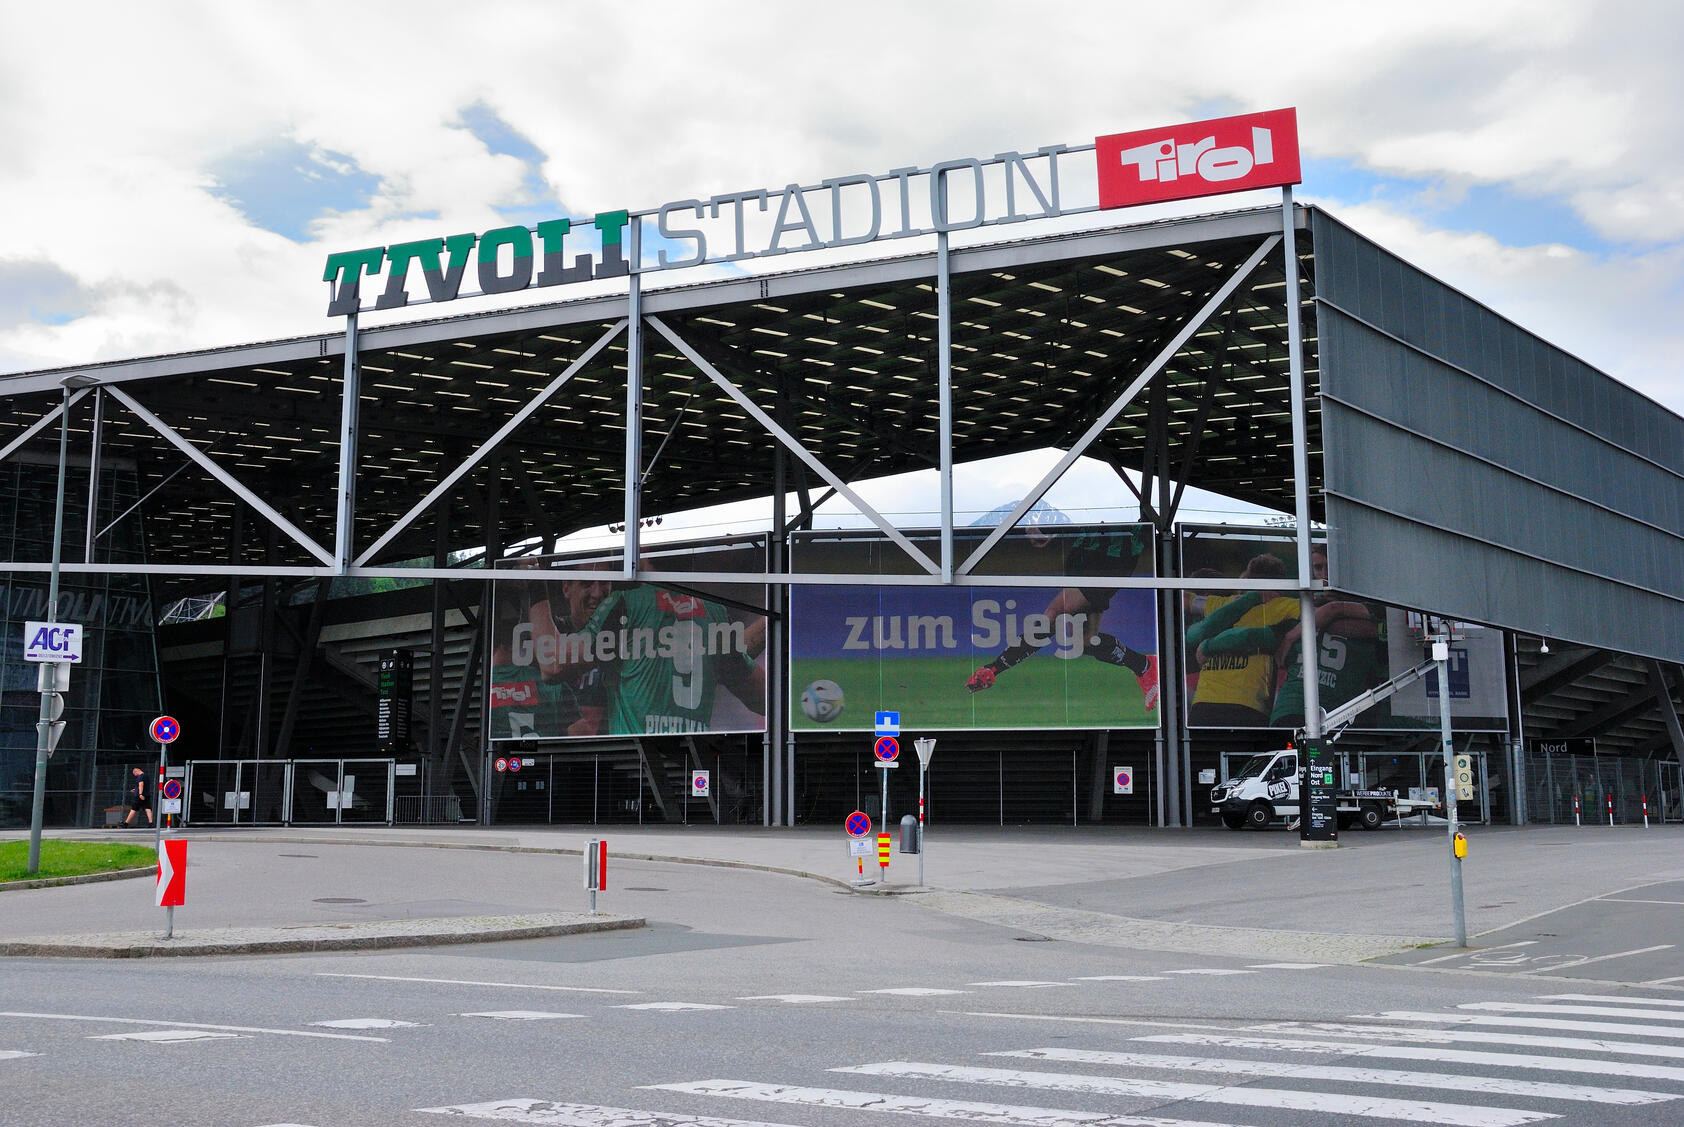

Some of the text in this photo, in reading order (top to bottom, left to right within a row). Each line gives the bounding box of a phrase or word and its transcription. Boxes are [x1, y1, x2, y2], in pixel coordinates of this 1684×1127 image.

[1121, 126, 1273, 182] Tirol
[323, 143, 1068, 317] TIVOLI STADION
[511, 615, 748, 667] Gemeinsam
[842, 600, 1101, 659] zum Sieg.
[1310, 765, 1333, 773] Eingang
[1540, 740, 1568, 753] Nord
